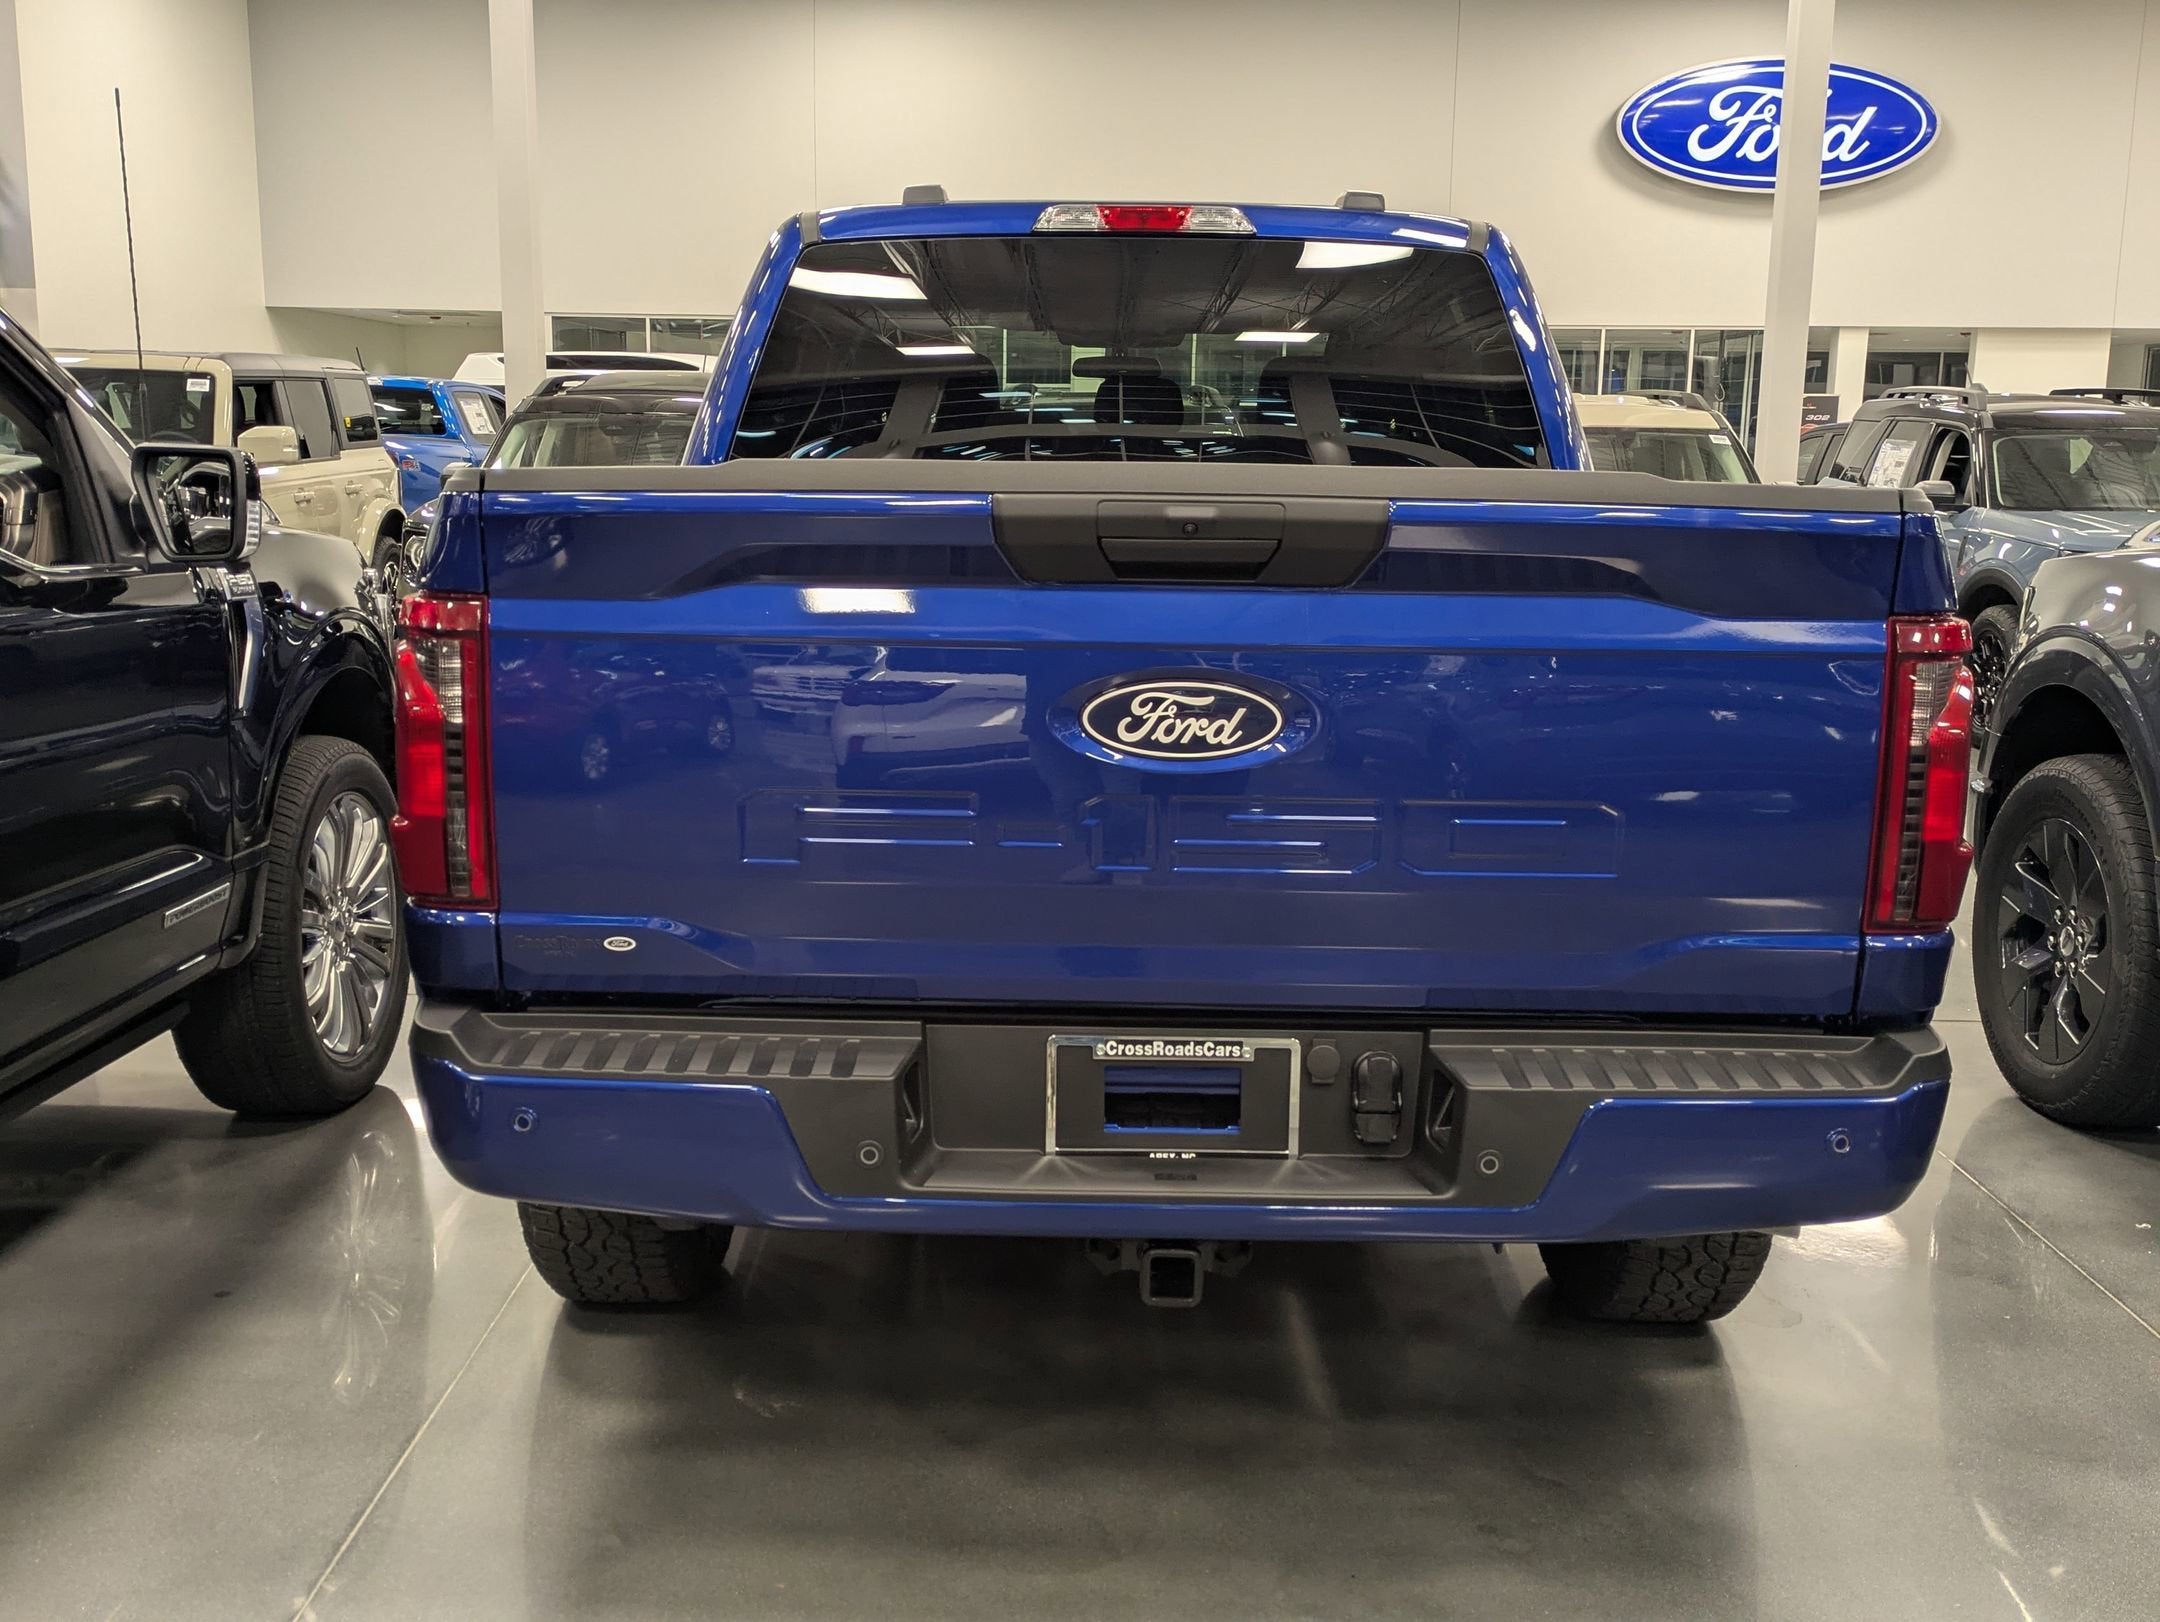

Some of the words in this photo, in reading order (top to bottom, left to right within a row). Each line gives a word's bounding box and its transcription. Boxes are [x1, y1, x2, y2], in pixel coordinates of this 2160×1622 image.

[1687, 85, 1878, 162] Fod
[1117, 692, 1247, 745] Ford
[1105, 1041, 1241, 1058] CrossRoadsCars
